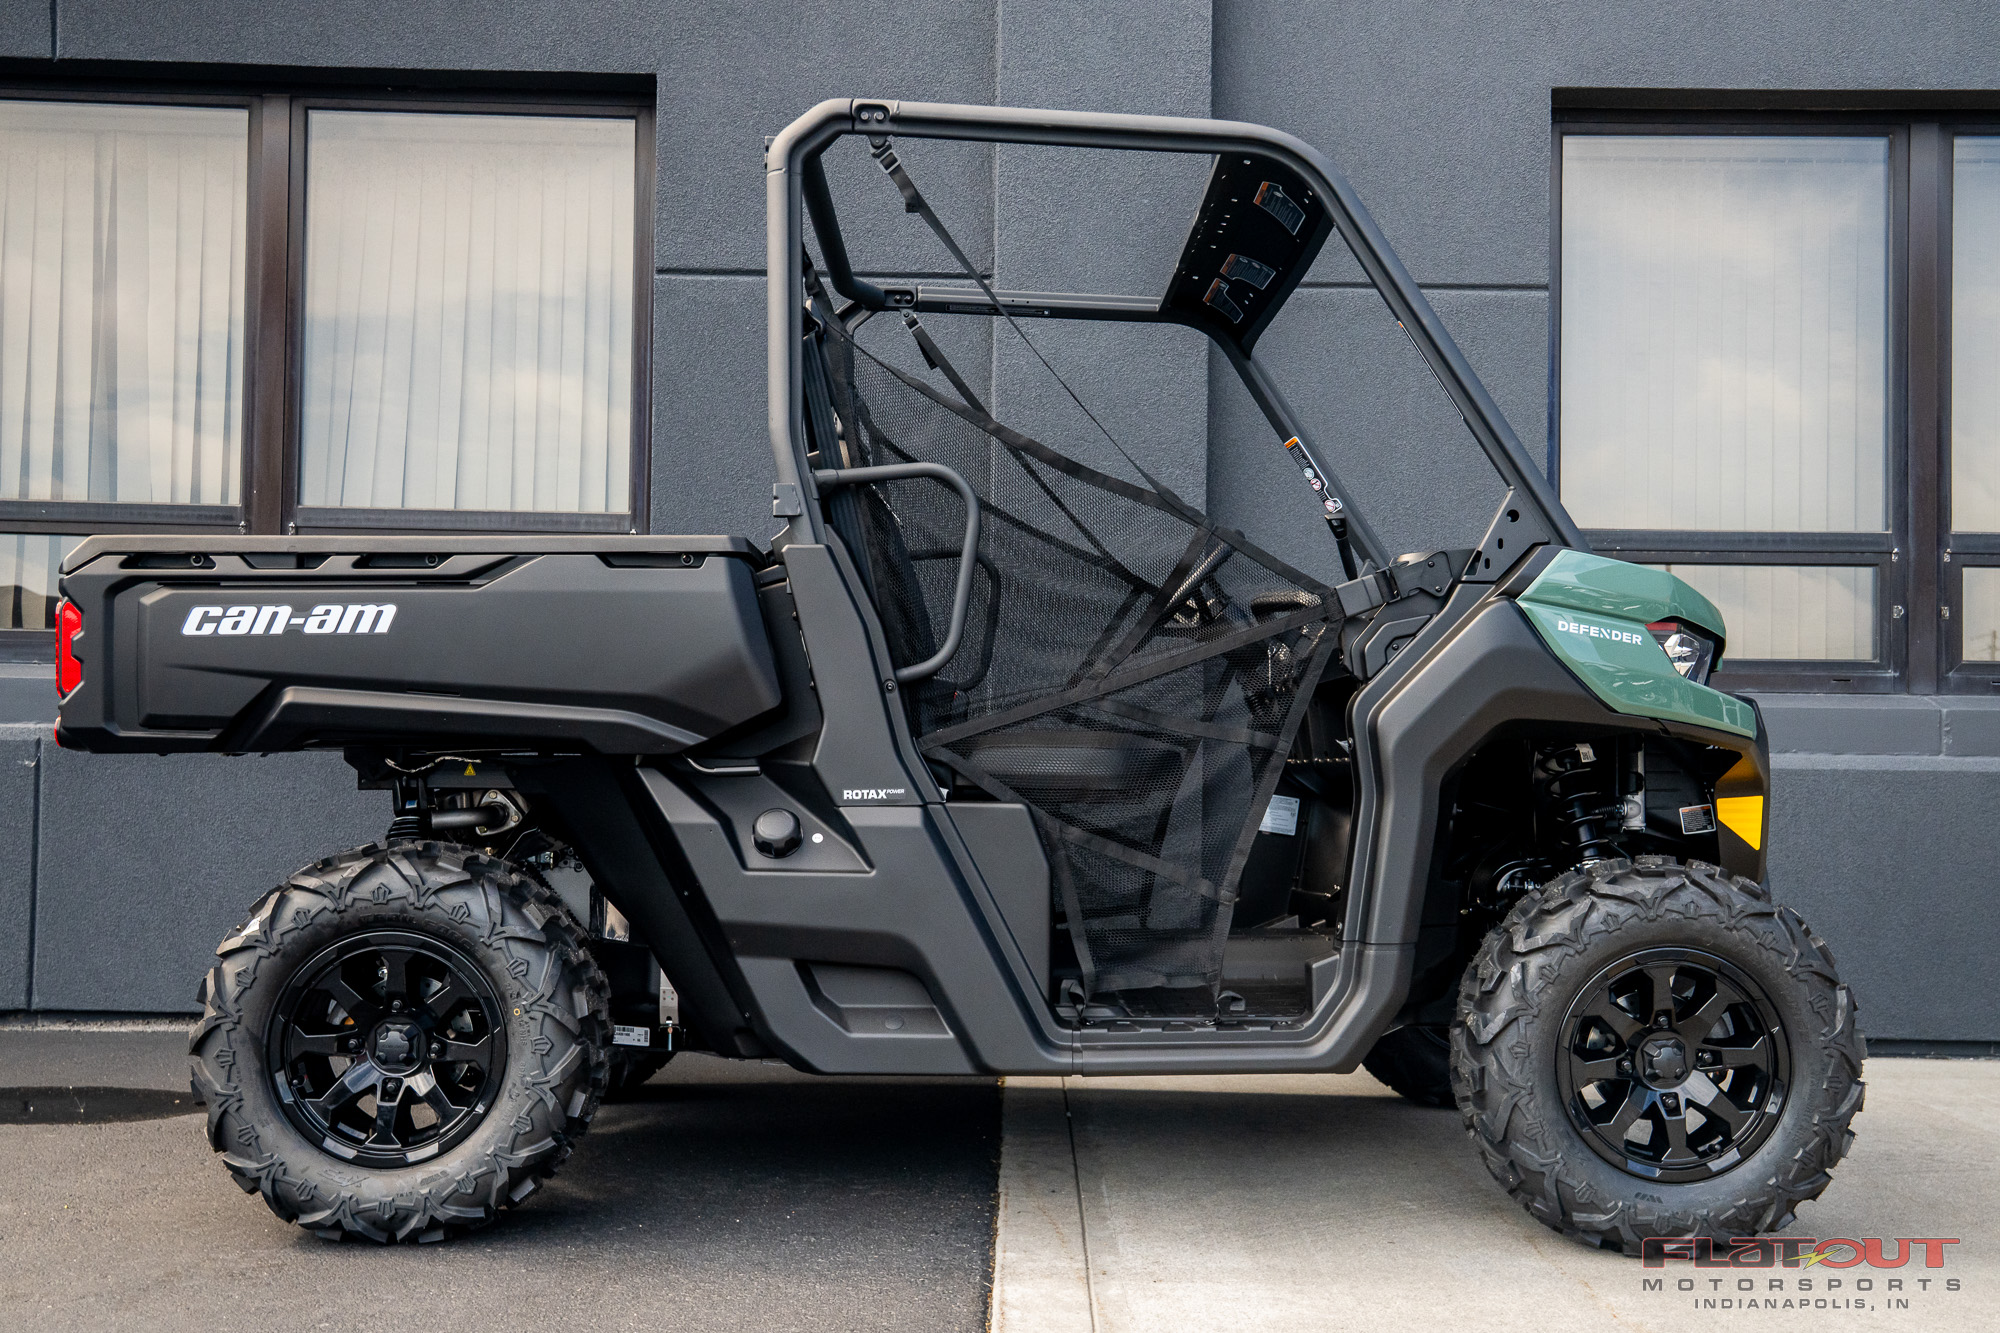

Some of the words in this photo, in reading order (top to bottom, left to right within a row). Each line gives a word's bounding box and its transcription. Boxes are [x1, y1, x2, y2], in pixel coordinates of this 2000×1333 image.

[181, 604, 397, 635] can-am
[1557, 620, 1643, 646] DEFENDER
[843, 789, 887, 800] ROTAX
